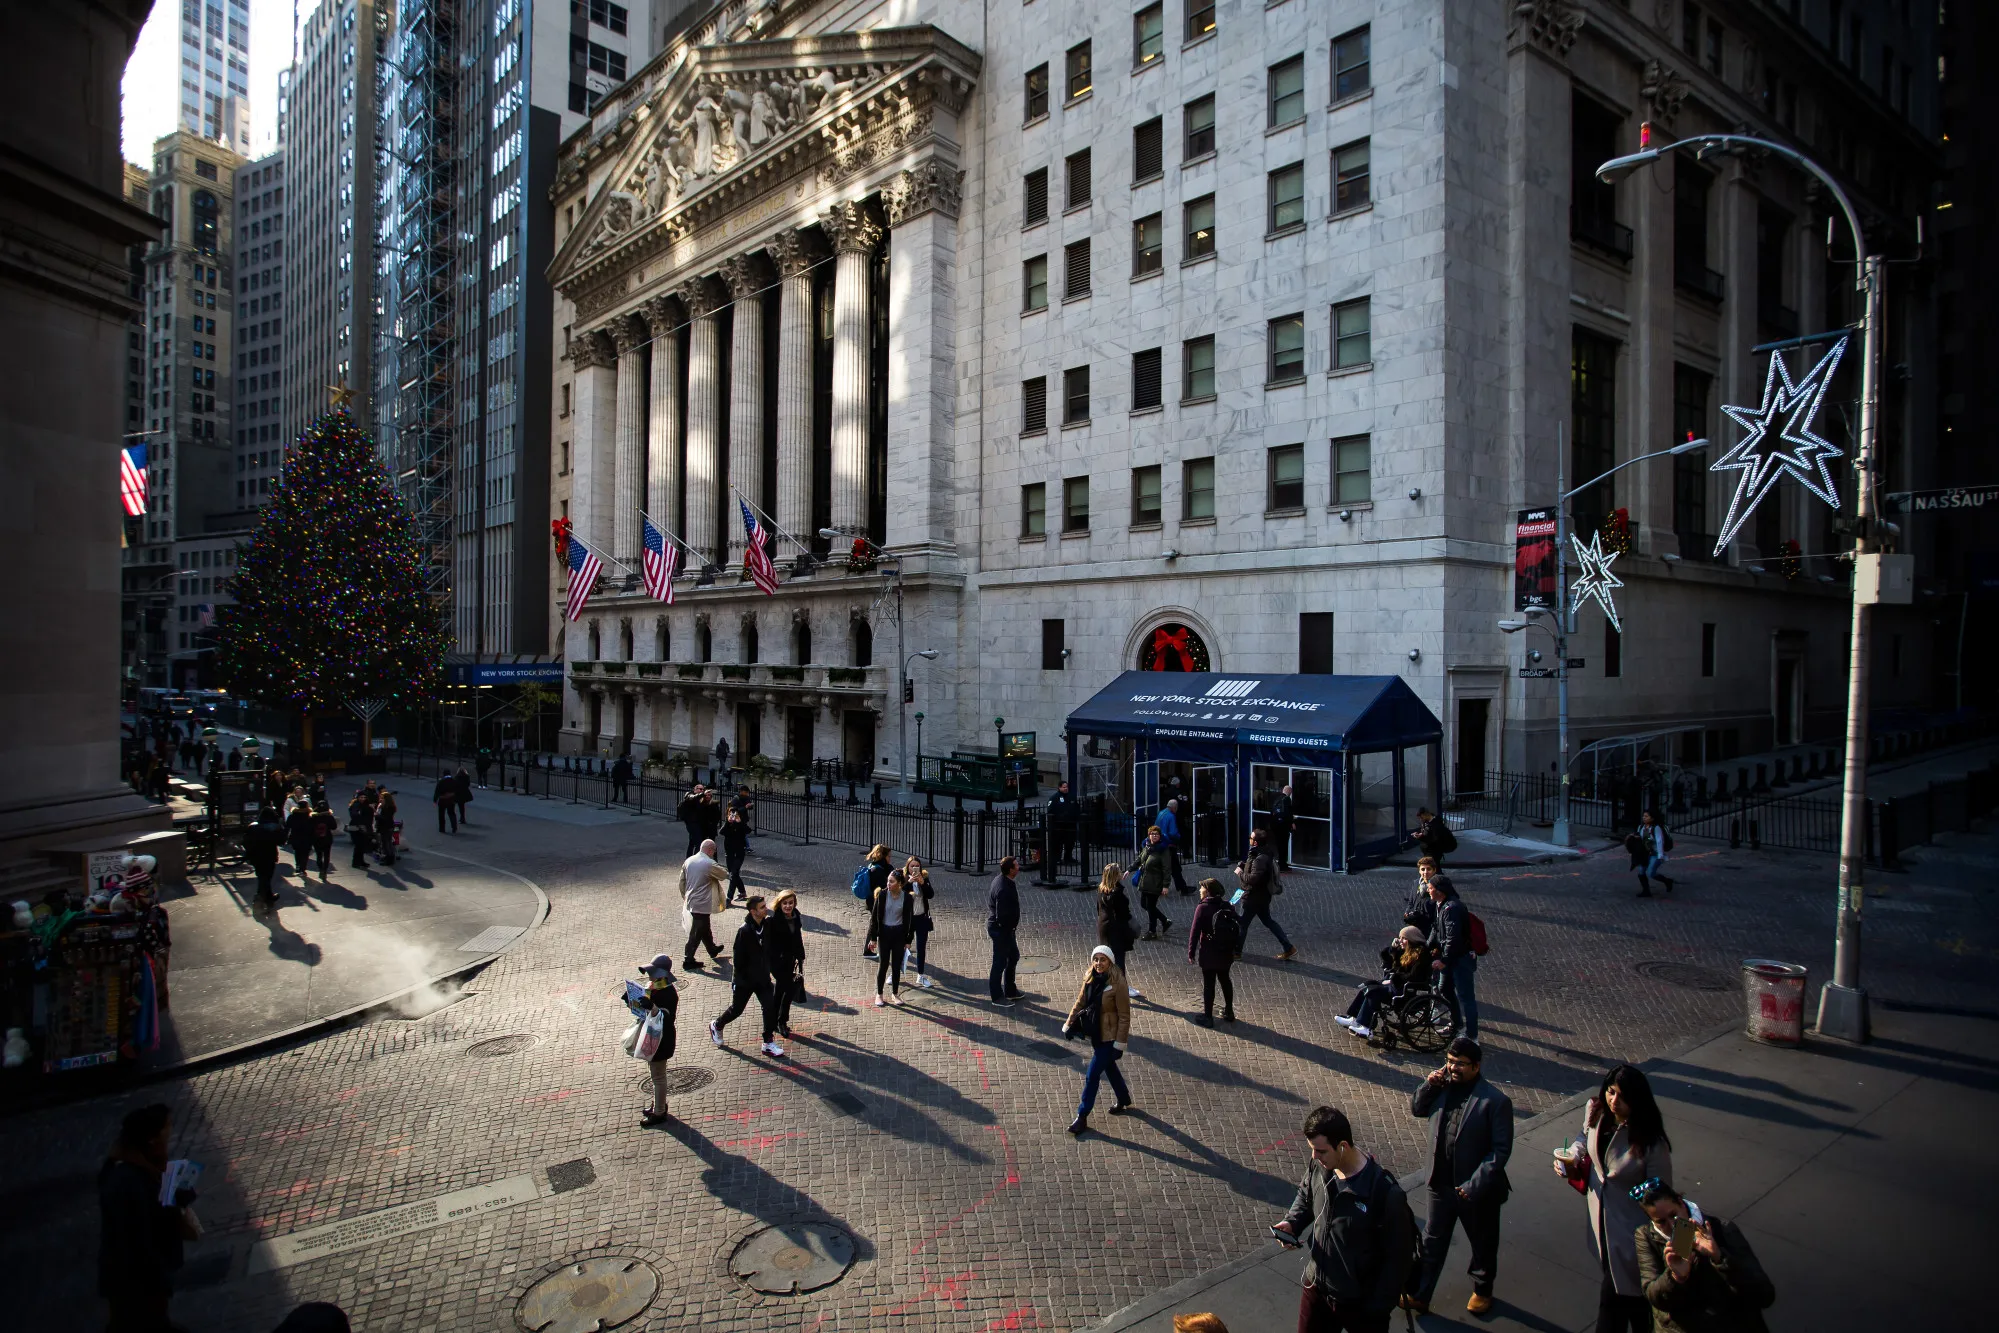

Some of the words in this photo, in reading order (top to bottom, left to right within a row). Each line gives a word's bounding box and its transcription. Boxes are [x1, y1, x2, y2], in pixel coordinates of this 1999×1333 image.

[674, 242, 696, 267] YORK
[733, 193, 787, 232] EXCHANGE
[1915, 492, 1985, 510] NASSAU
[1986, 492, 1999, 500] ST
[1528, 512, 1545, 520] NYC
[1518, 522, 1554, 534] financial
[1529, 596, 1543, 604] bgc
[1130, 694, 1159, 704] NEW
[1160, 695, 1195, 705] YORK
[1194, 697, 1241, 707] STOCK
[1155, 728, 1188, 737] EMPLOYEE
[1188, 730, 1224, 739] ENTRANCE
[1249, 734, 1296, 744] REGISTERED
[1297, 738, 1328, 747] GUESTS
[944, 762, 961, 770] Subway
[91, 865, 126, 874] GLASS
[416, 1217, 439, 1227] WALL
[378, 1224, 413, 1237] STREET
[330, 1234, 376, 1249] PALISADE
